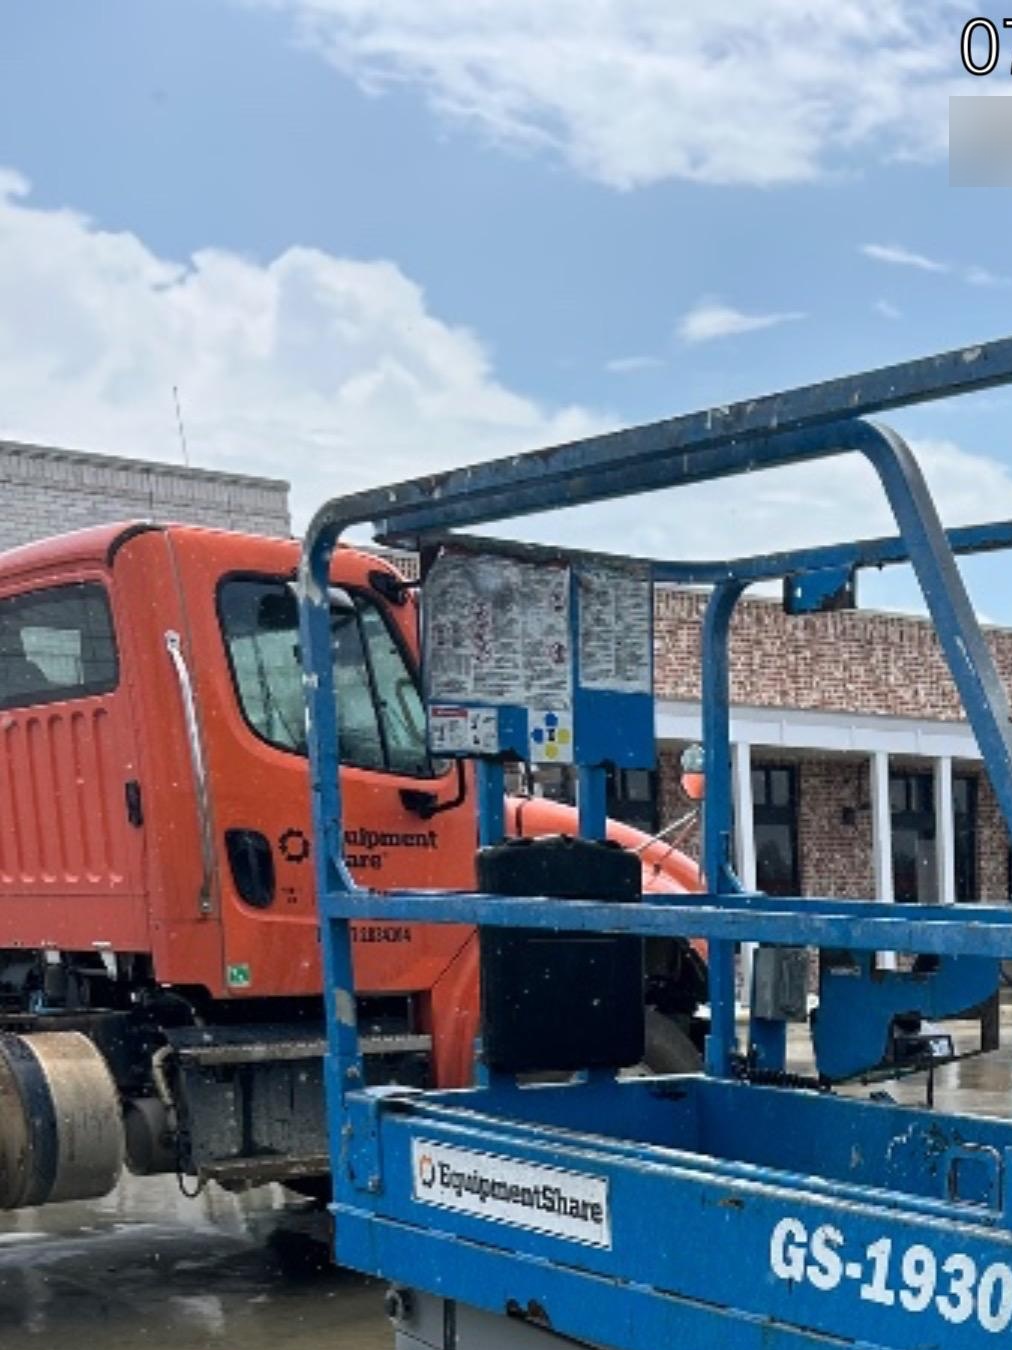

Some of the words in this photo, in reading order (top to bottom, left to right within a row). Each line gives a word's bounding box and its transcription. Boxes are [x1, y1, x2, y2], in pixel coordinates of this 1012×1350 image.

[344, 828, 437, 849] uipment
[345, 853, 381, 870] are
[437, 1160, 604, 1225] EquipmentShare
